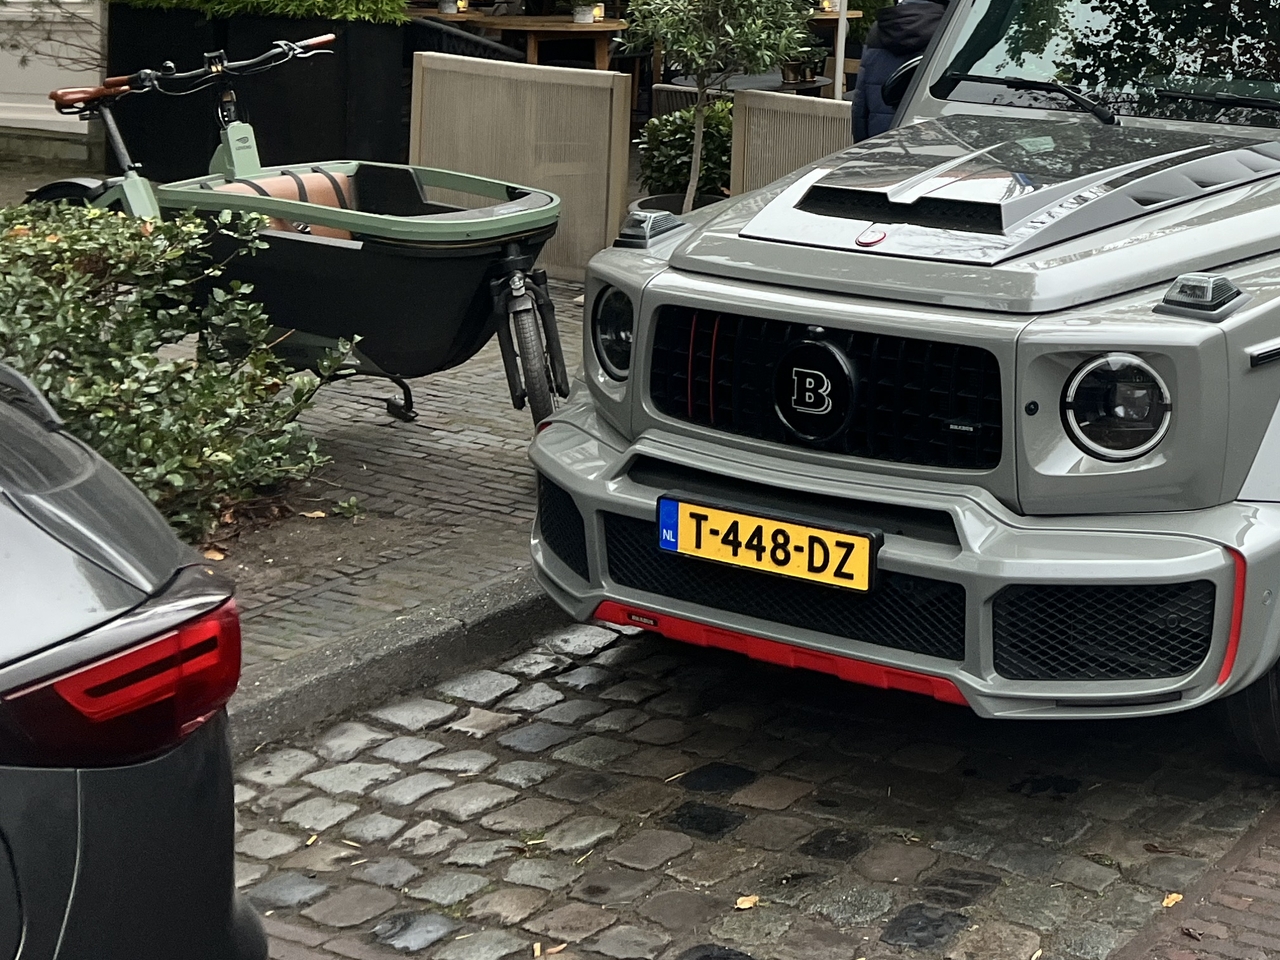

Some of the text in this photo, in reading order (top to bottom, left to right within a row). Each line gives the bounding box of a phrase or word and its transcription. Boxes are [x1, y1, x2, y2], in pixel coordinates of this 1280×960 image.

[791, 367, 833, 415] B
[662, 529, 676, 542] NL
[689, 511, 856, 581] T-448-DZ
